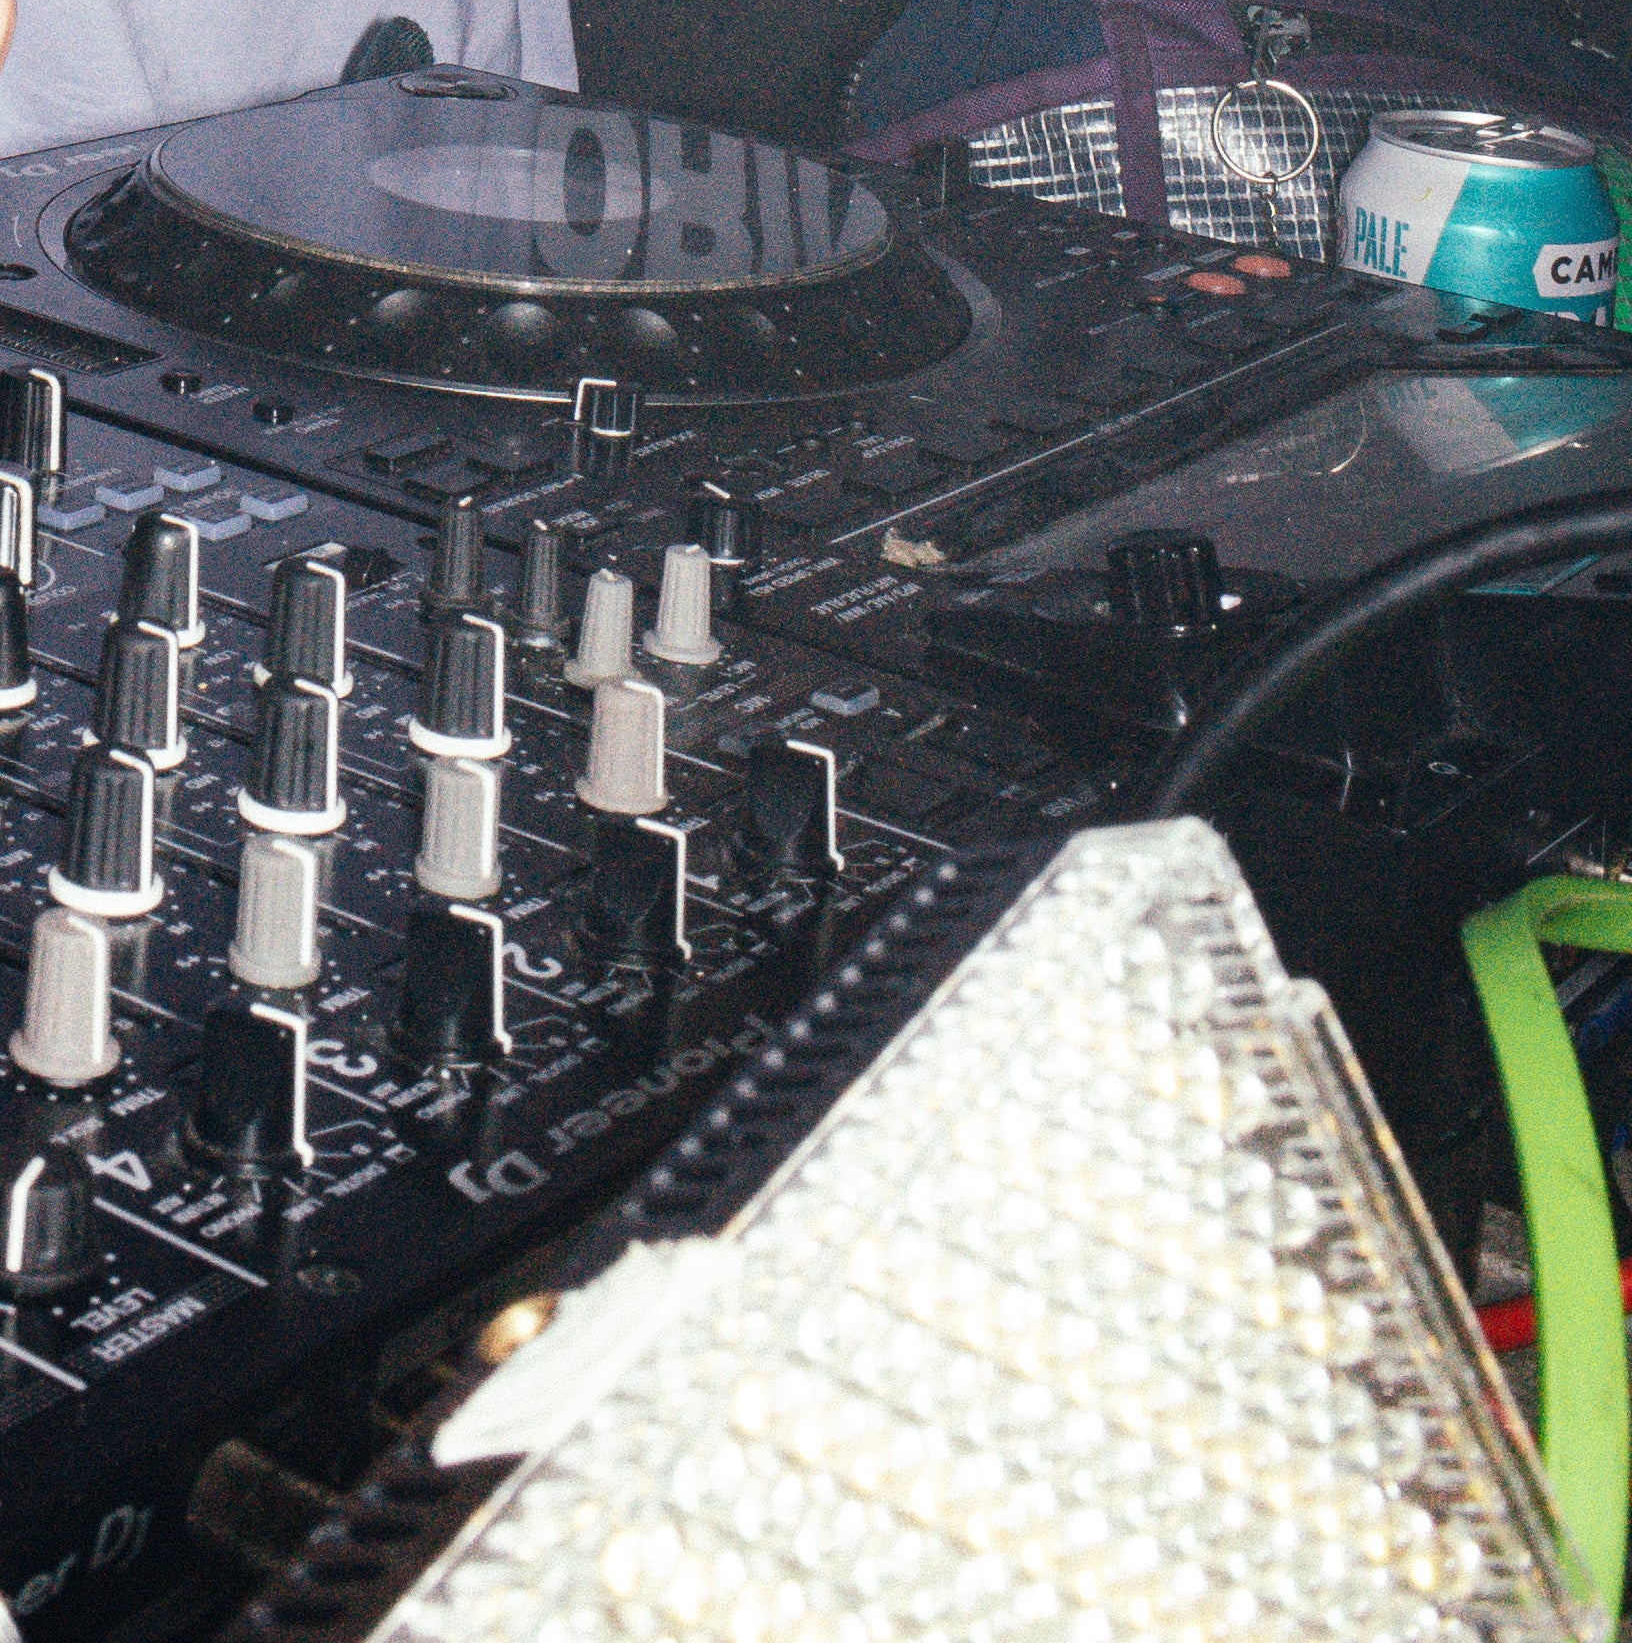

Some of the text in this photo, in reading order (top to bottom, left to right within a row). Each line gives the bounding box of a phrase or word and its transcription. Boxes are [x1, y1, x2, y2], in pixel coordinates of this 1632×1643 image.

[1354, 205, 1409, 280] PALE
[1550, 246, 1619, 285] CAM
[304, 1037, 379, 1078] 3
[107, 1084, 167, 1116] TRIM
[447, 1015, 771, 1204] Pioneer DJ
[85, 1148, 153, 1192] 4
[69, 1286, 156, 1332] LEVEL
[90, 1294, 206, 1364] MASTER
